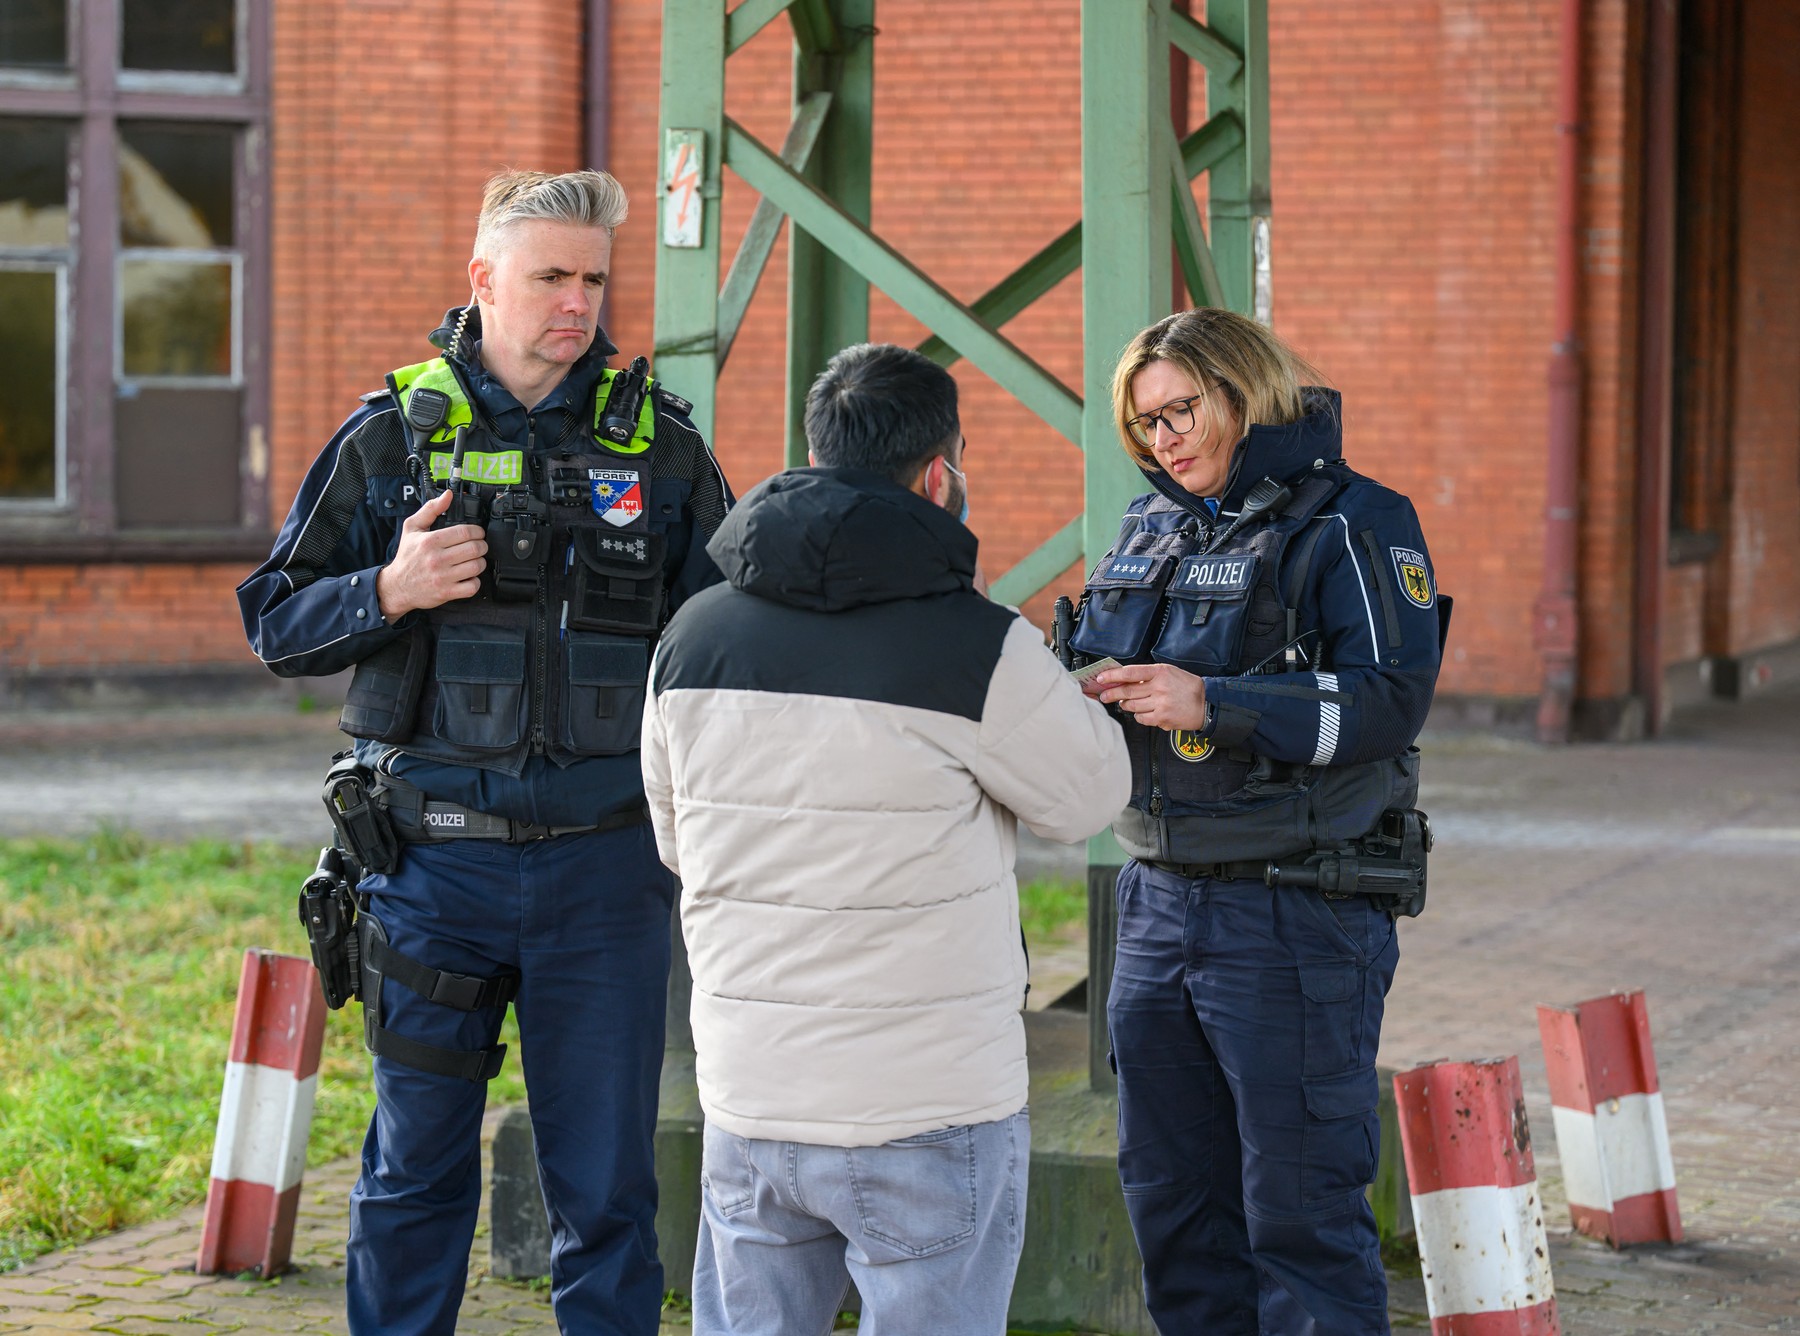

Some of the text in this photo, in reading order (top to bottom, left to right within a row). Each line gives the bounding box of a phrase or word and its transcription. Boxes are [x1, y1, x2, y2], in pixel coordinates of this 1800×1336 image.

[433, 454, 517, 480] PLIZEI
[1185, 562, 1246, 585] POLIZEI
[423, 812, 465, 827] POLIZEI
